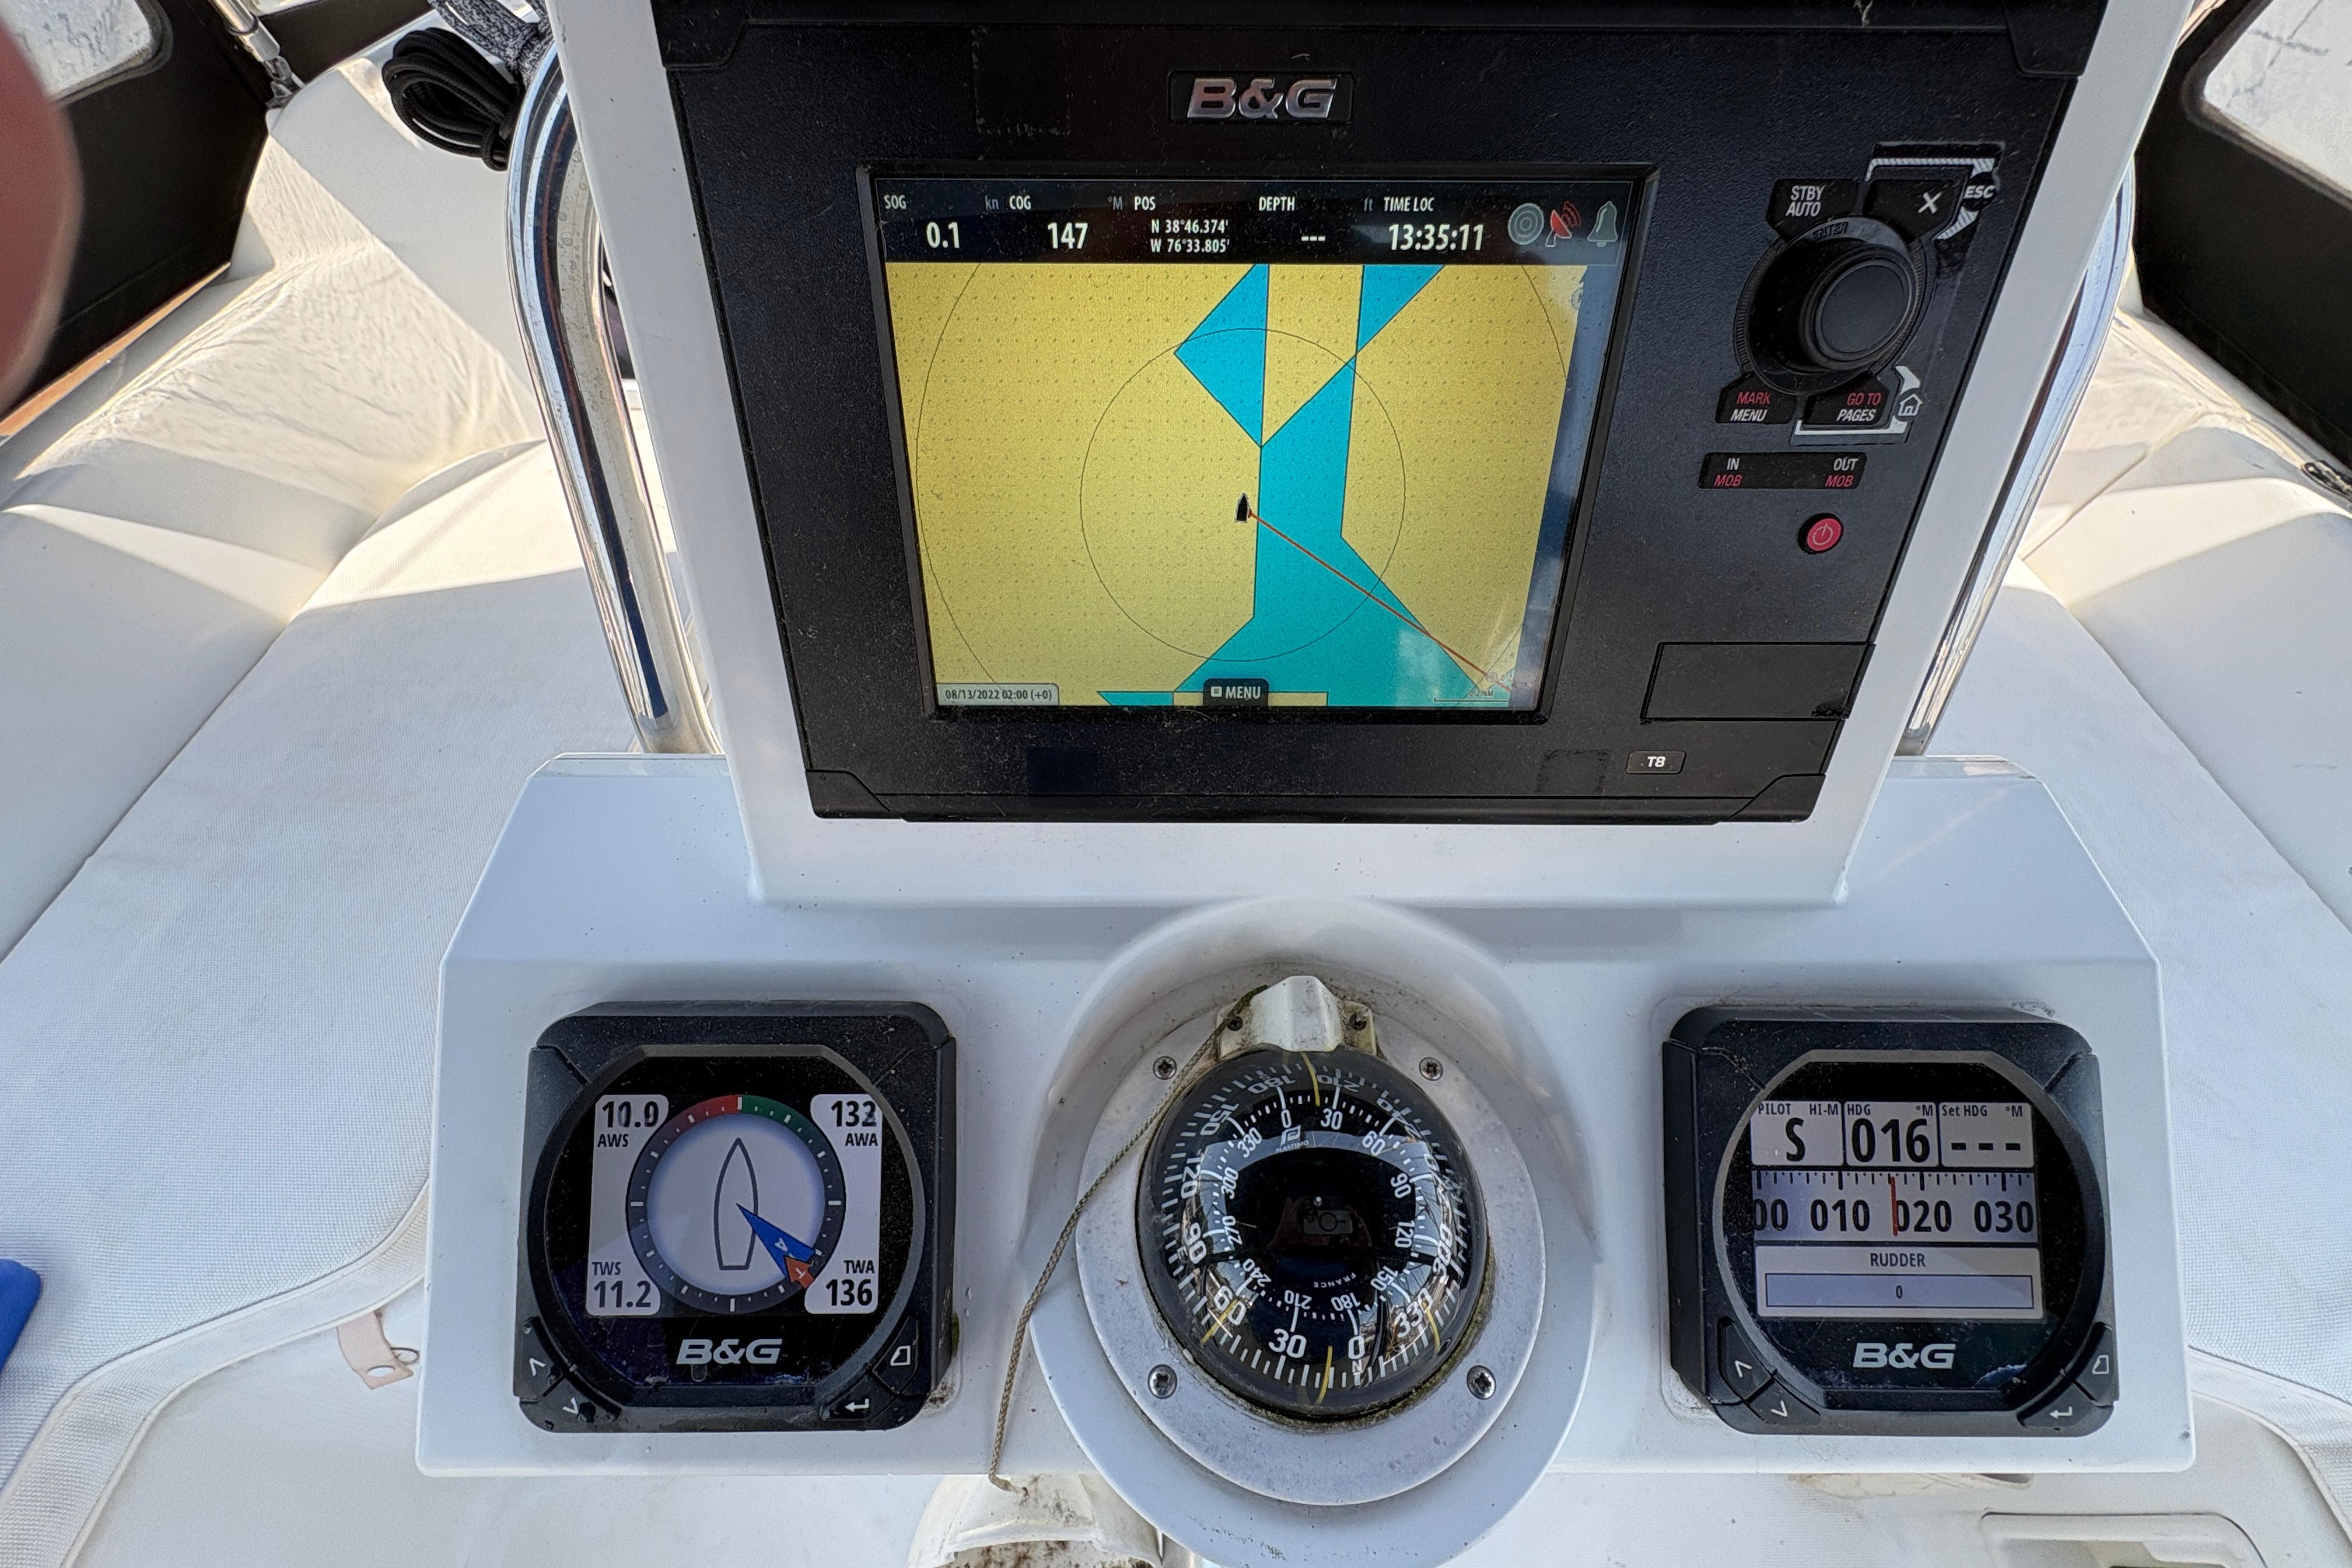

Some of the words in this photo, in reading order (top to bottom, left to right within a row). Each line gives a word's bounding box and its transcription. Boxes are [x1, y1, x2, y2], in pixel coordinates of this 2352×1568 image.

[1187, 78, 1338, 119] B&G
[1791, 184, 1826, 201] STBY
[1964, 185, 1996, 199] ESC
[884, 195, 907, 209] SOG
[985, 196, 999, 210] kn
[1009, 196, 1031, 210] COG
[1134, 196, 1156, 211] POS
[1259, 197, 1295, 211] DEPTH
[1384, 197, 1410, 211] TIME
[1413, 197, 1434, 211] LOC
[1786, 201, 1821, 216] AUTO
[1151, 219, 1160, 233] N
[926, 222, 960, 249] 0.1
[1048, 222, 1088, 249] 147
[1388, 224, 1484, 251] 13:35:11
[1150, 238, 1161, 253] W
[1736, 392, 1772, 405] MARK
[1847, 393, 1864, 405] GO
[1866, 393, 1881, 405] TO
[1730, 410, 1768, 422] MENU
[1836, 409, 1876, 422] PAGES
[1726, 458, 1740, 471] IN
[1833, 458, 1859, 471] OUT
[1714, 474, 1743, 487] MOB
[1825, 474, 1854, 487] MOB
[945, 690, 1000, 700] 08/13/2022
[1002, 690, 1028, 699] 02:00
[1030, 690, 1052, 701] (+0)
[1225, 686, 1261, 699] MENU
[1647, 756, 1667, 768] T8
[1248, 1075, 1296, 1094] 180
[831, 1101, 877, 1127] 132
[1758, 1103, 1791, 1115] PILOT
[1847, 1104, 1871, 1116] HDG
[1942, 1105, 1960, 1117] Set
[1964, 1105, 1988, 1117] HDG
[1200, 1103, 1240, 1135] 150
[1281, 1110, 1292, 1129] 0
[1321, 1108, 1343, 1130] 30
[597, 1133, 629, 1147] AWS
[845, 1133, 878, 1146] AWA
[1237, 1127, 1263, 1158] 330
[1362, 1130, 1385, 1157] 60
[1786, 1118, 1805, 1162] S
[1852, 1118, 1930, 1164] 016
[1221, 1167, 1239, 1199] 300
[1390, 1173, 1412, 1199] 90
[1811, 1199, 1870, 1232] 010
[1896, 1200, 1952, 1233] 020
[1973, 1200, 2034, 1233] 030
[1222, 1216, 1243, 1245] 270
[1395, 1220, 1415, 1248] 120
[592, 1261, 621, 1276] TWS
[844, 1260, 874, 1274] TWA
[1870, 1253, 1926, 1268] RUDDER
[1242, 1258, 1272, 1287] 240
[1314, 1272, 1357, 1288] FRANCE
[1371, 1266, 1398, 1291] 150
[593, 1280, 652, 1308] 11.2
[825, 1279, 872, 1306] 136
[1284, 1290, 1312, 1310] 210
[1895, 1284, 1903, 1300] 0
[1213, 1285, 1247, 1325] 60
[1331, 1292, 1361, 1311] 180
[1398, 1287, 1433, 1338] 330
[676, 1338, 782, 1364] B&G
[1268, 1328, 1307, 1358] 30
[1348, 1336, 1365, 1360] 0
[1853, 1343, 1957, 1370] B&G
